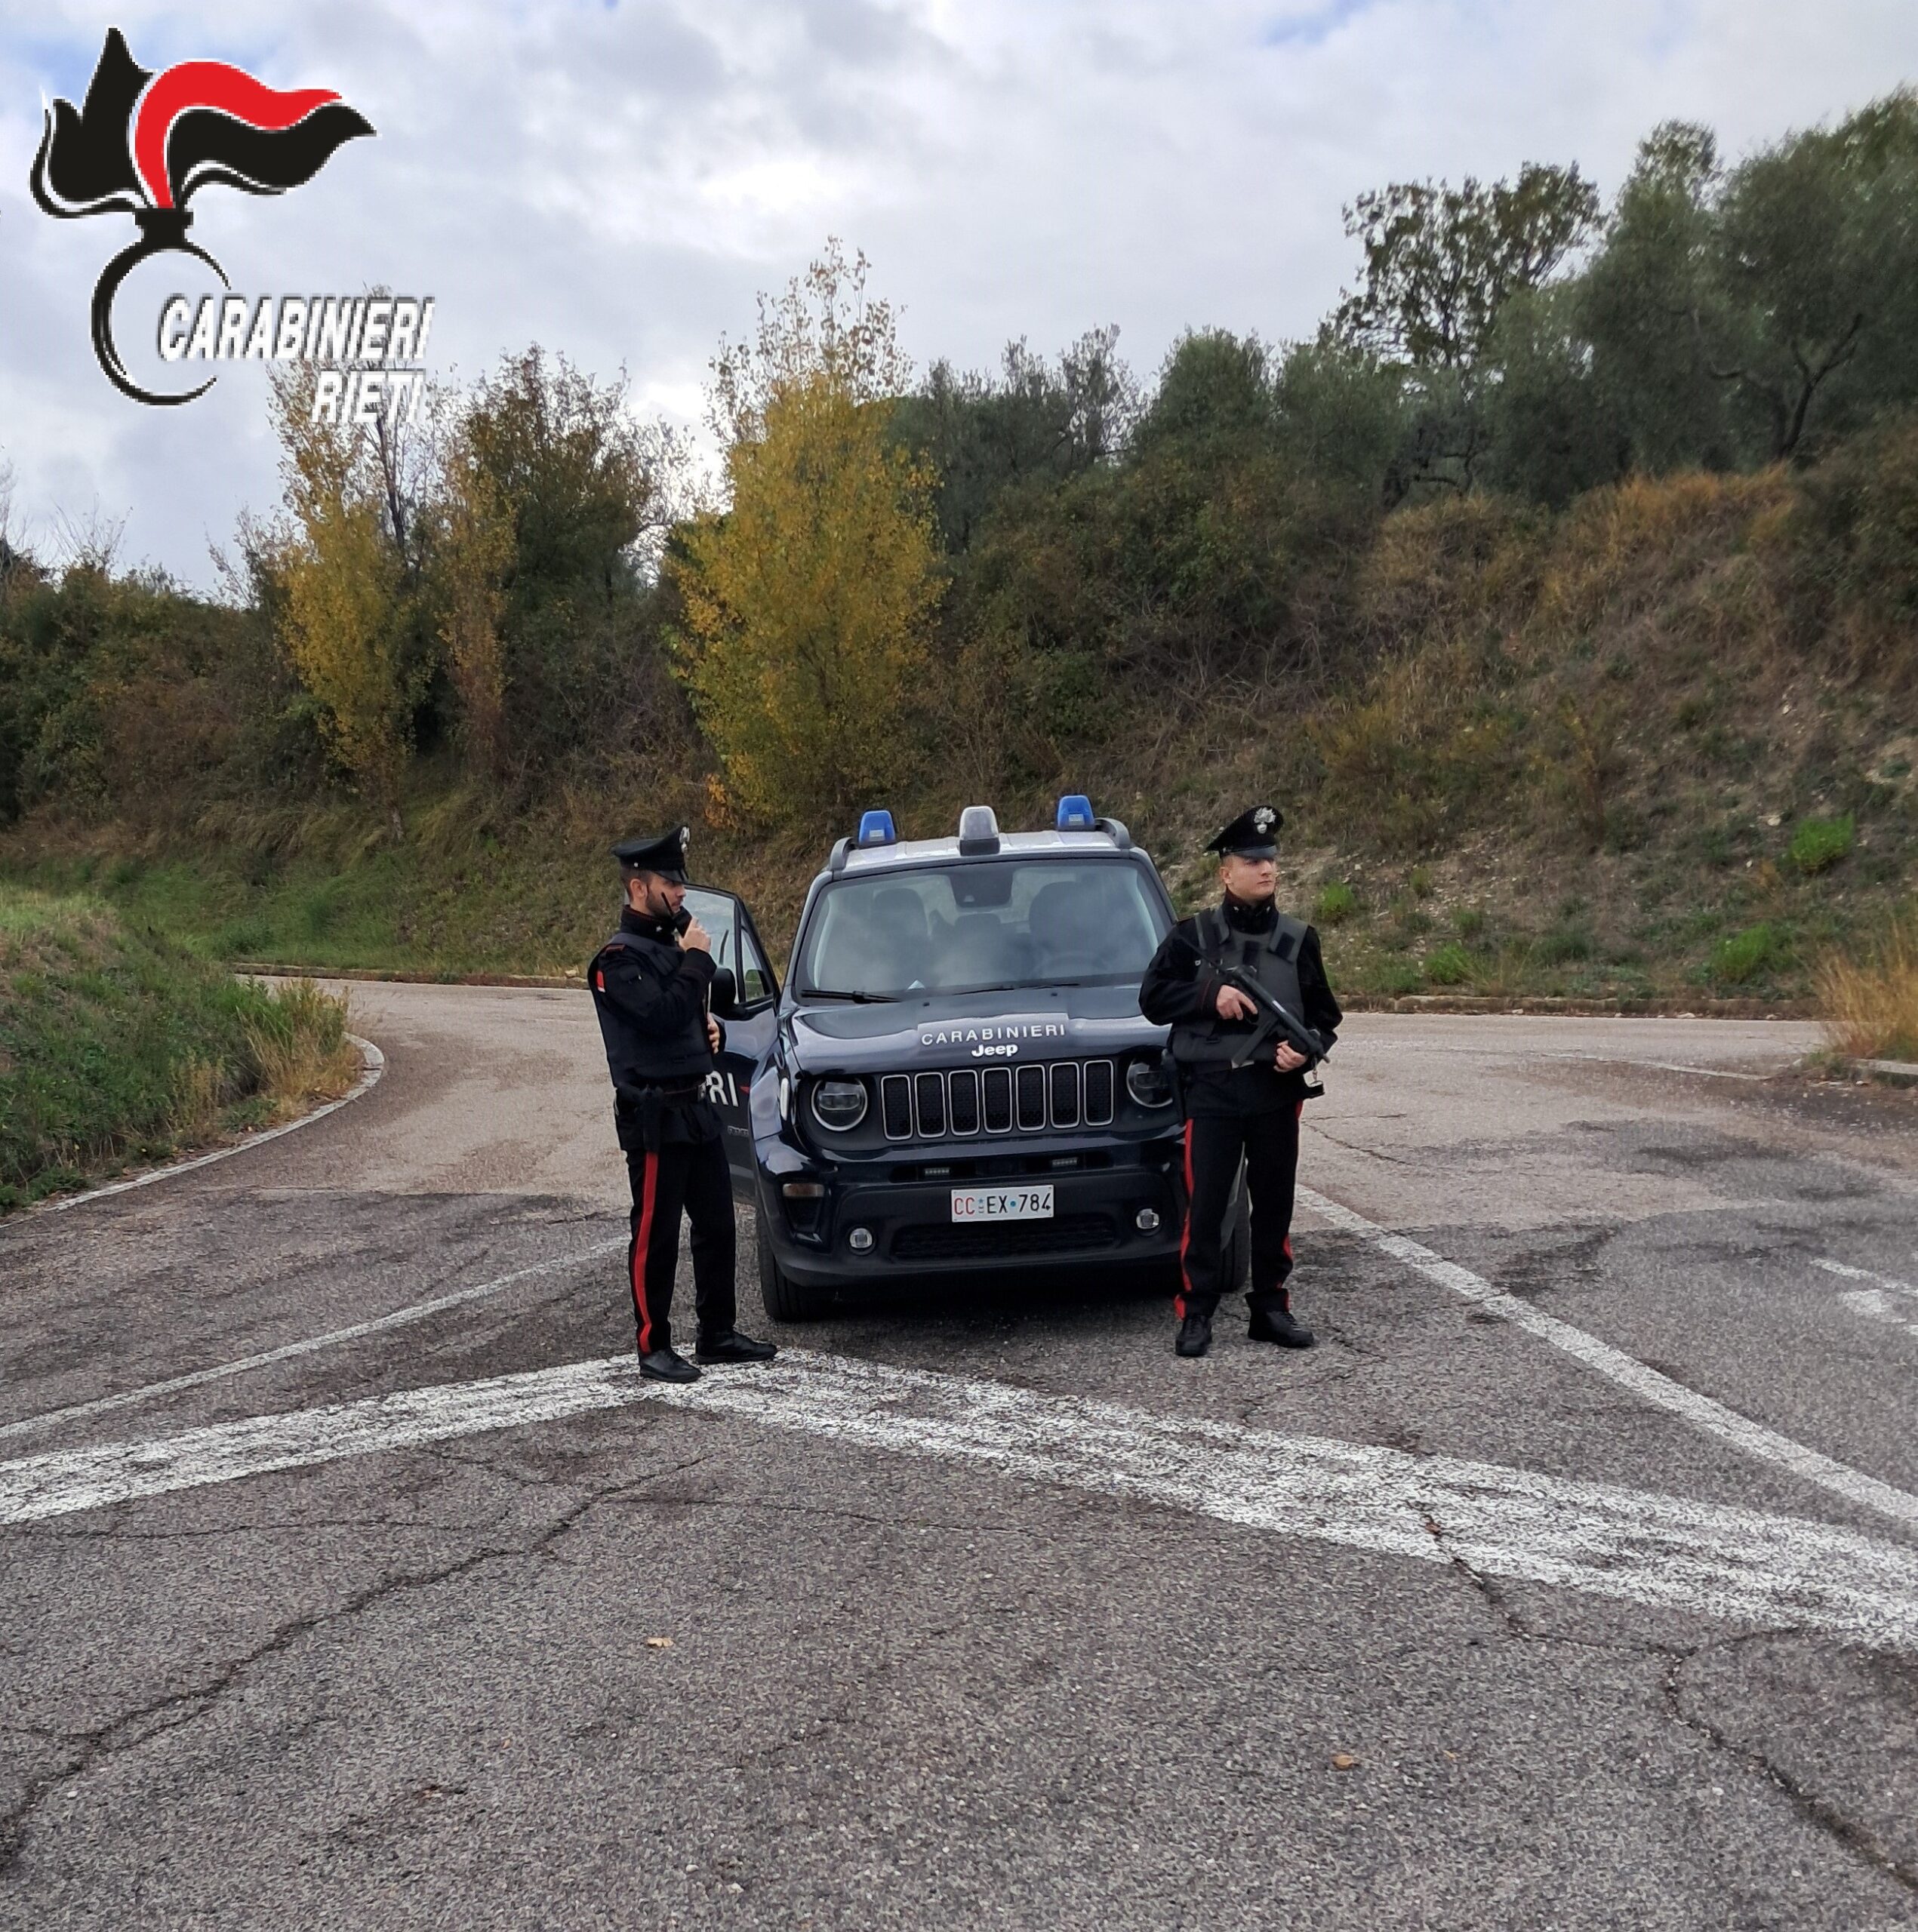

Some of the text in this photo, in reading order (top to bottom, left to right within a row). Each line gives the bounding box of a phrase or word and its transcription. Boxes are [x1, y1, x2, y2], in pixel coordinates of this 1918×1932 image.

[921, 1023, 1065, 1046] CARABINIERI
[971, 1043, 1018, 1057] Jeep
[954, 1192, 1051, 1215] CC EX 784
